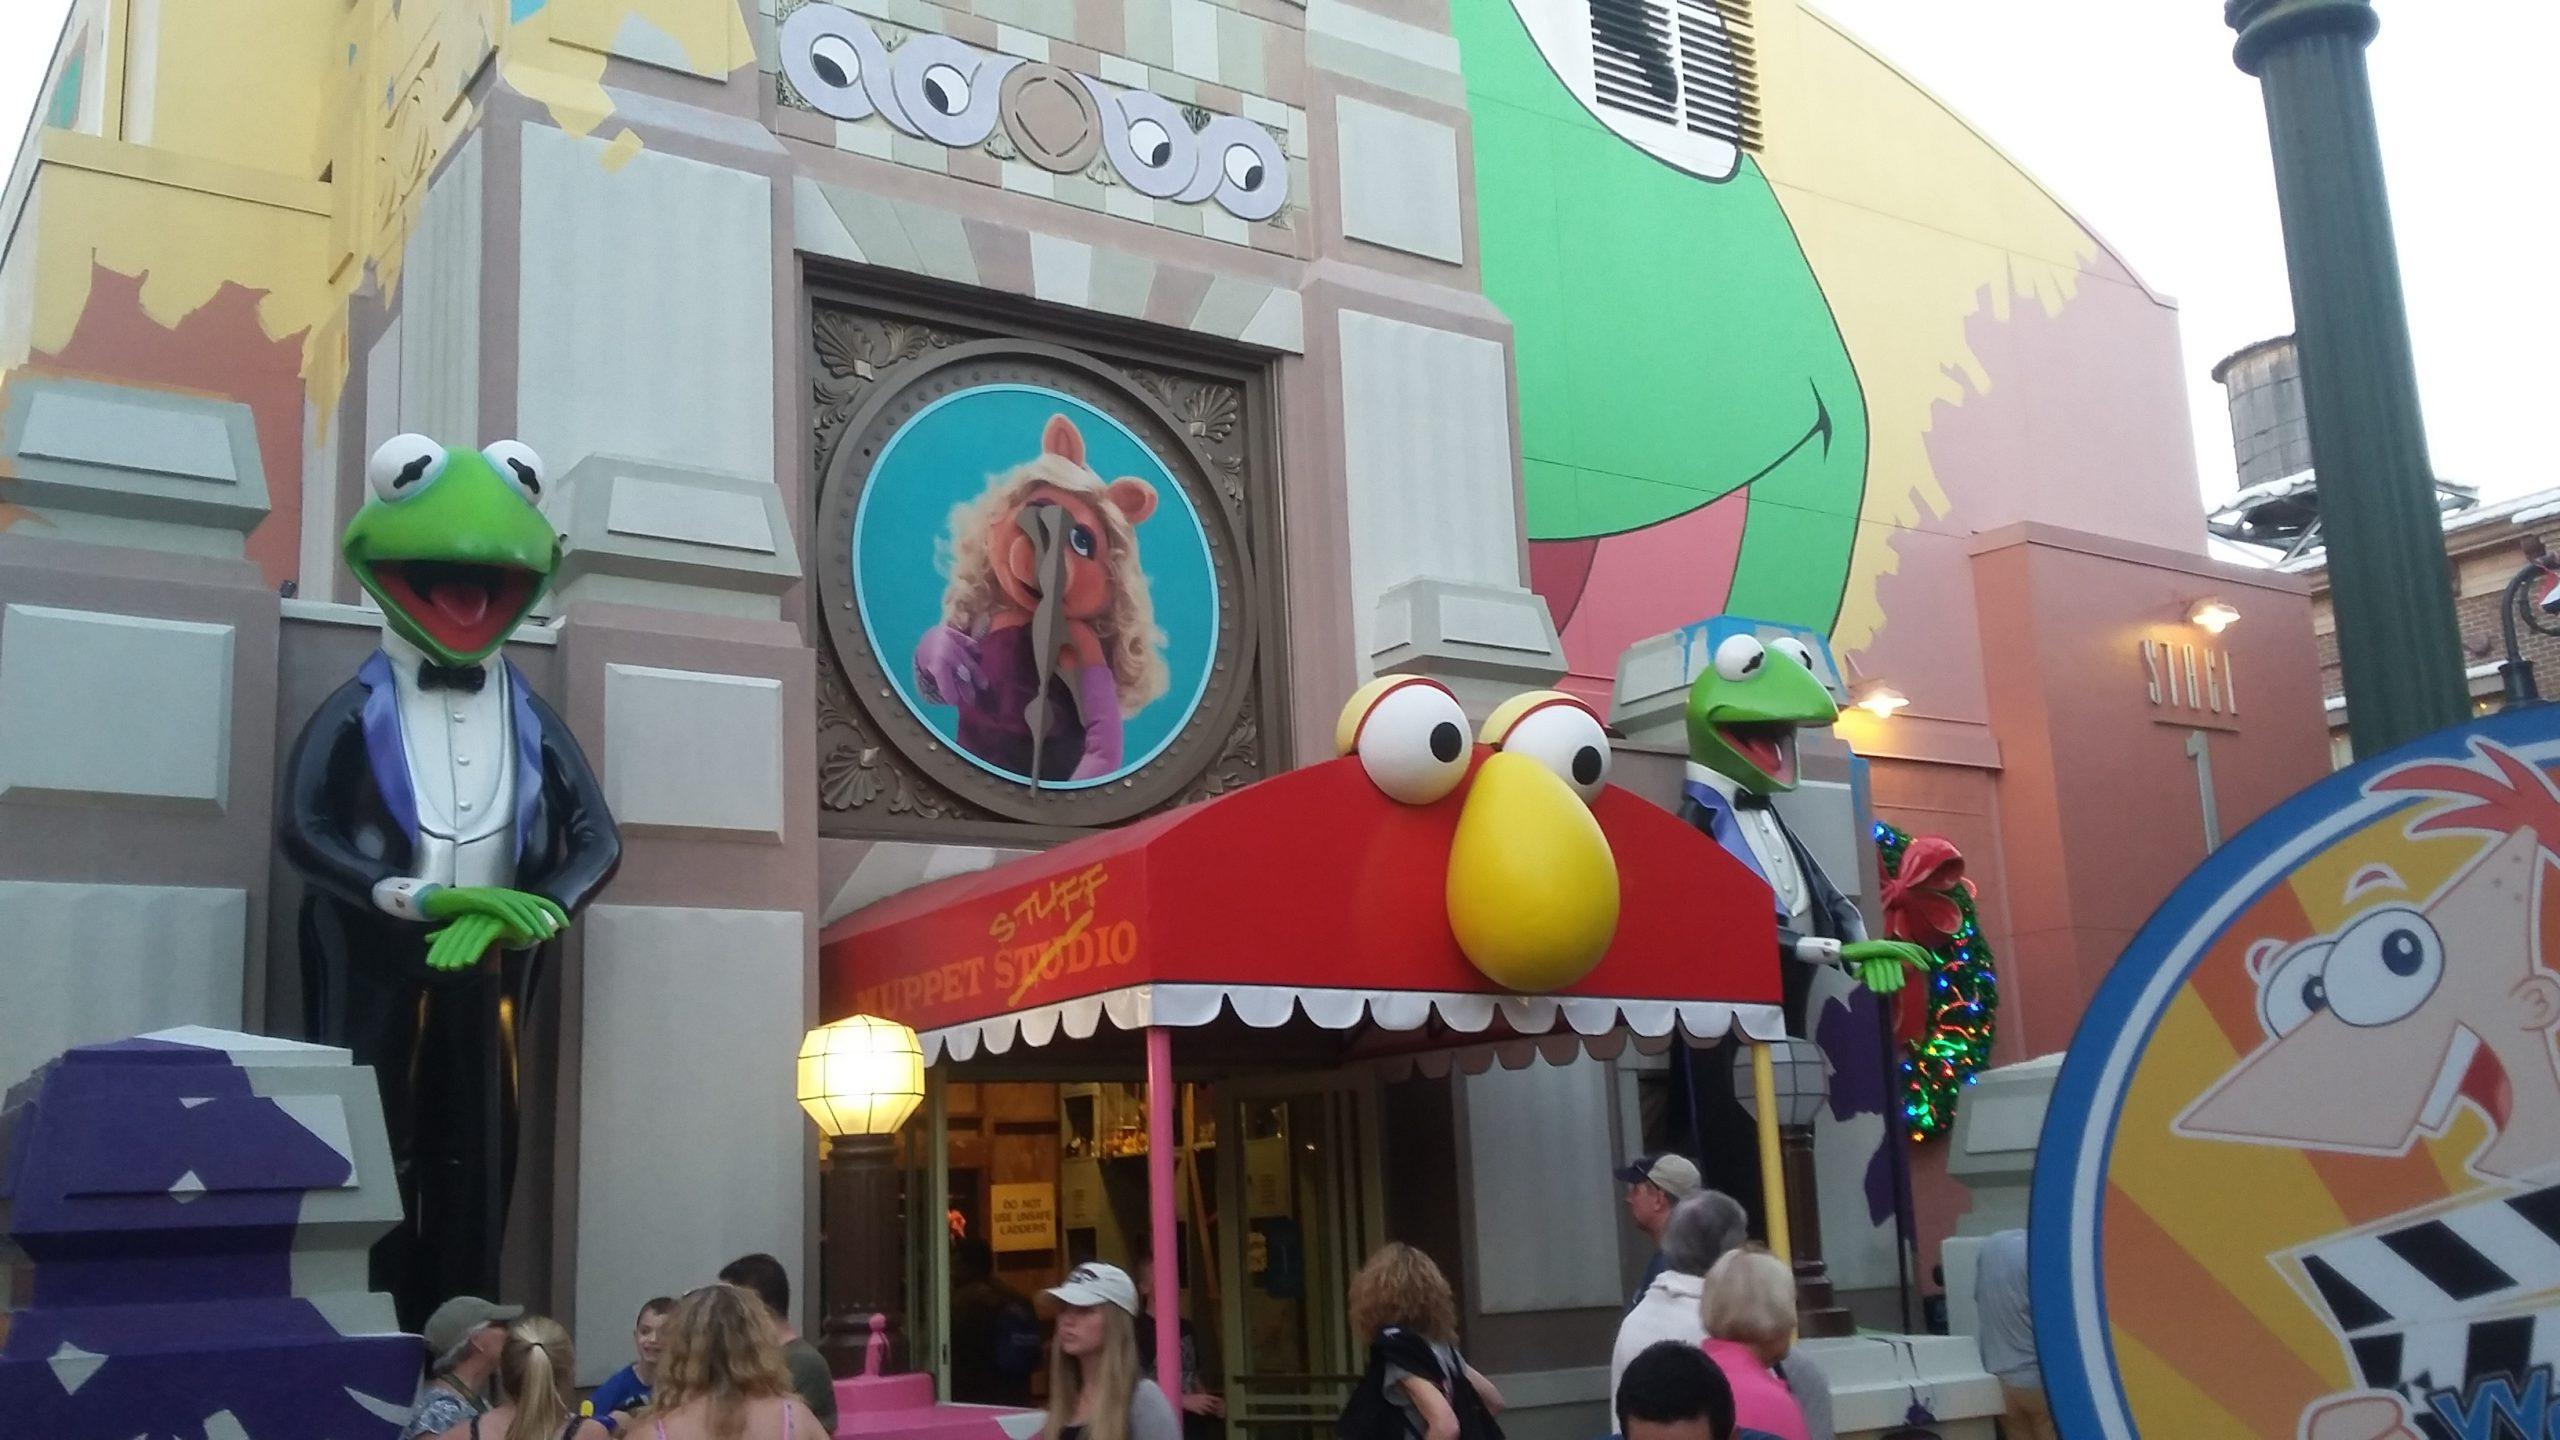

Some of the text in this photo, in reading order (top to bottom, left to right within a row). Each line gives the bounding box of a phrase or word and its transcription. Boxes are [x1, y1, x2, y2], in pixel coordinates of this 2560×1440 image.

[988, 862, 1109, 943] STUFF
[856, 920, 1138, 1016] MUPPET STUDIO
[1003, 1197, 1043, 1210] DO NOT
[994, 1210, 1053, 1223] USE UNSAFE
[999, 1222, 1048, 1235] LADDERS
